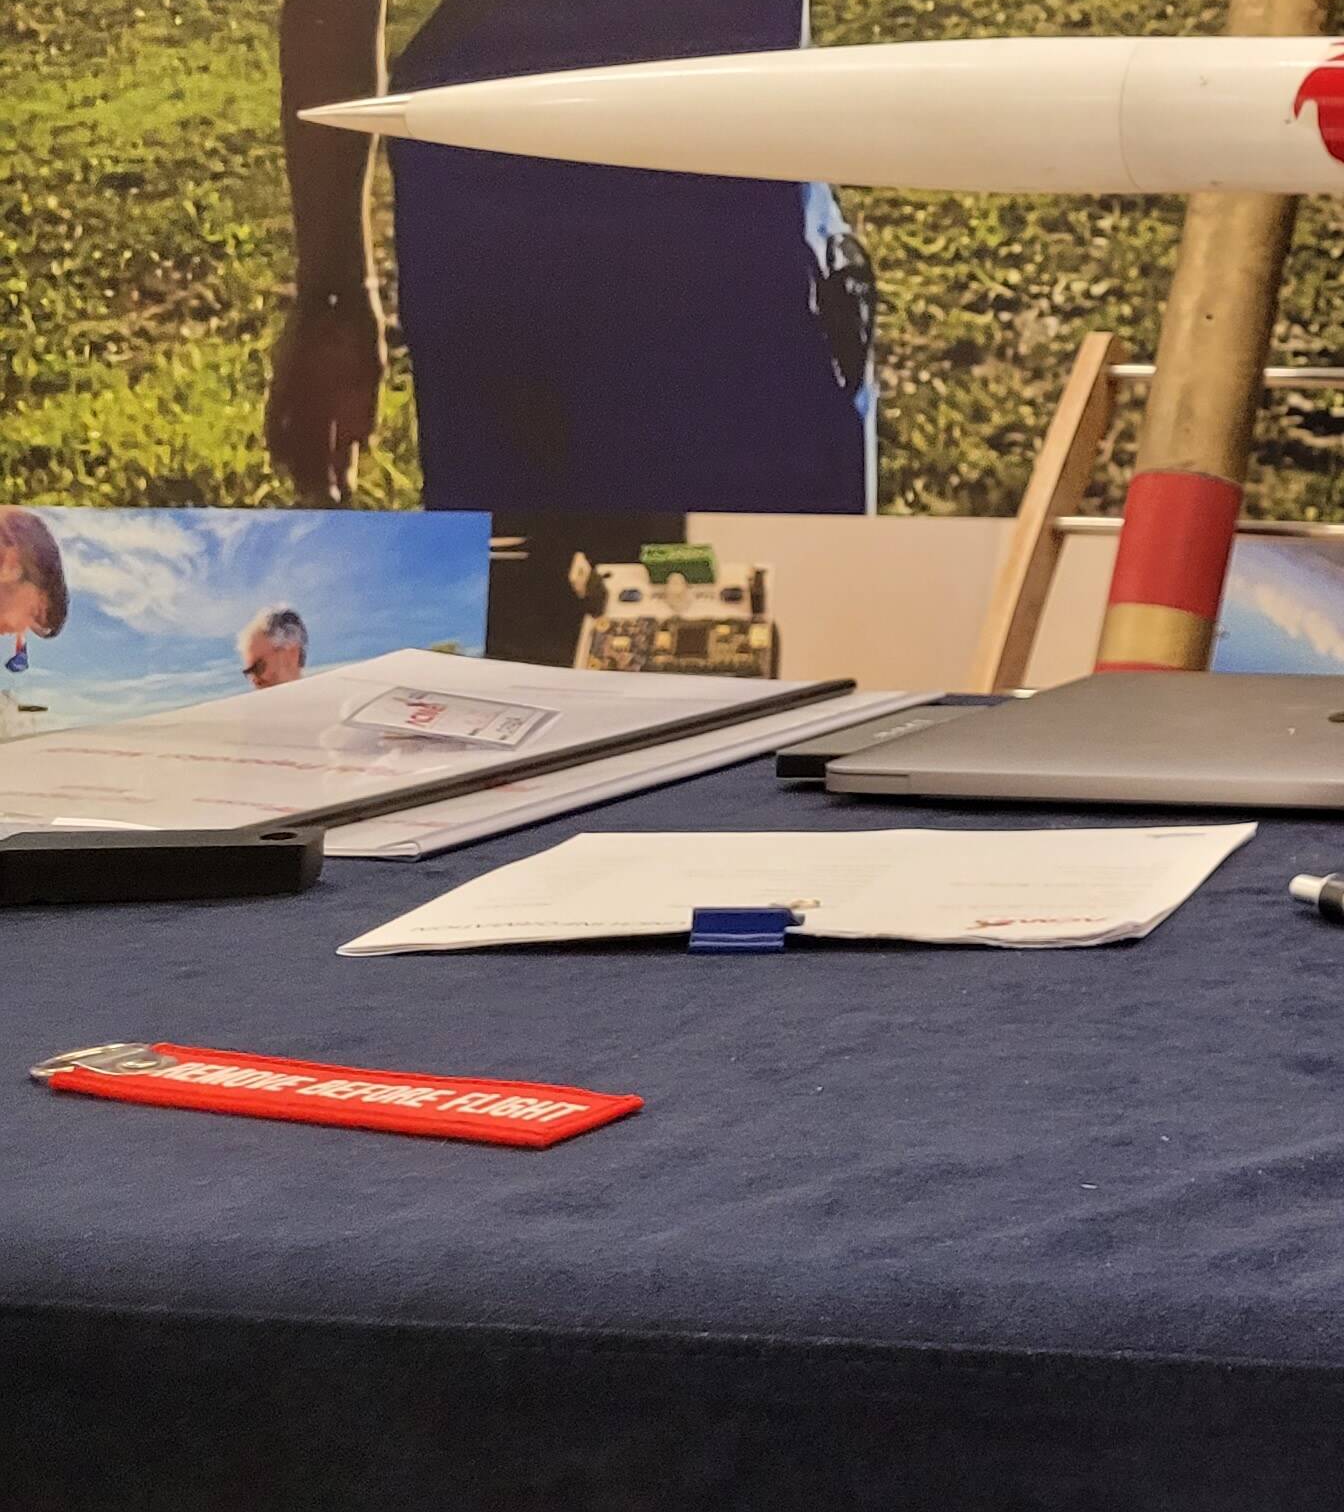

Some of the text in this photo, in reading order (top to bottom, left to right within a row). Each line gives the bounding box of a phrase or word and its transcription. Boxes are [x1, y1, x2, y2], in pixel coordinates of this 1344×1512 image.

[156, 1062, 591, 1123] REMOVE BEFORE FLIGHT
